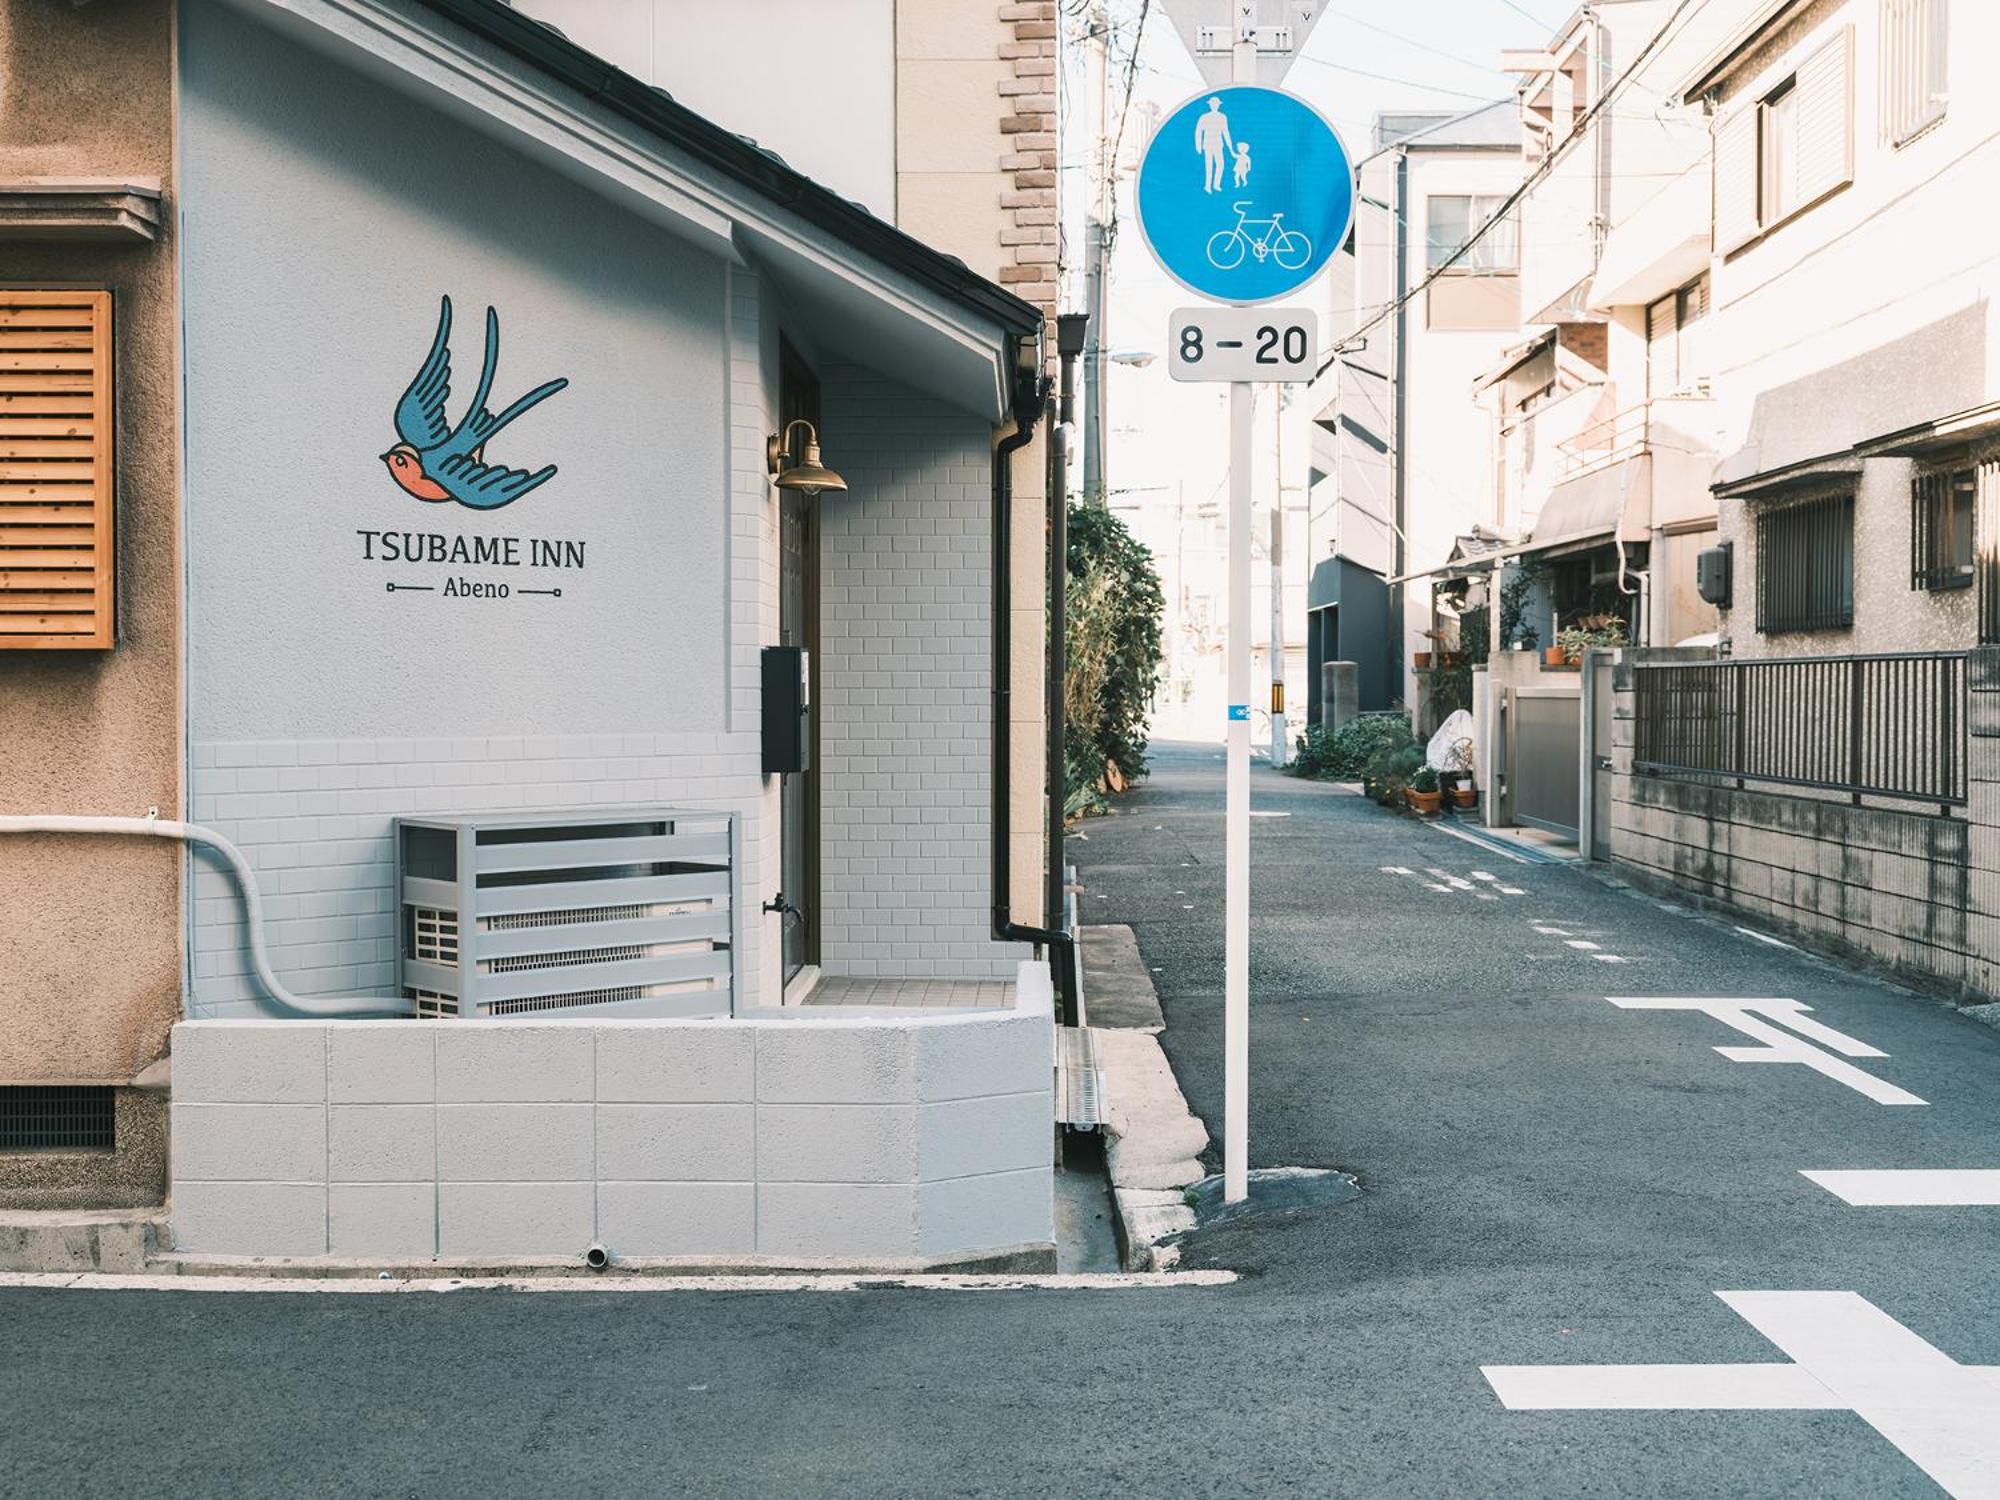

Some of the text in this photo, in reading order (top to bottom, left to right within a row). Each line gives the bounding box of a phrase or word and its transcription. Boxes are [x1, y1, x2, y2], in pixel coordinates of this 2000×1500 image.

[1179, 325, 1204, 363] 8
[1255, 325, 1307, 364] 20
[357, 529, 586, 569] TSUBAME INN
[443, 577, 510, 599] Abeno
